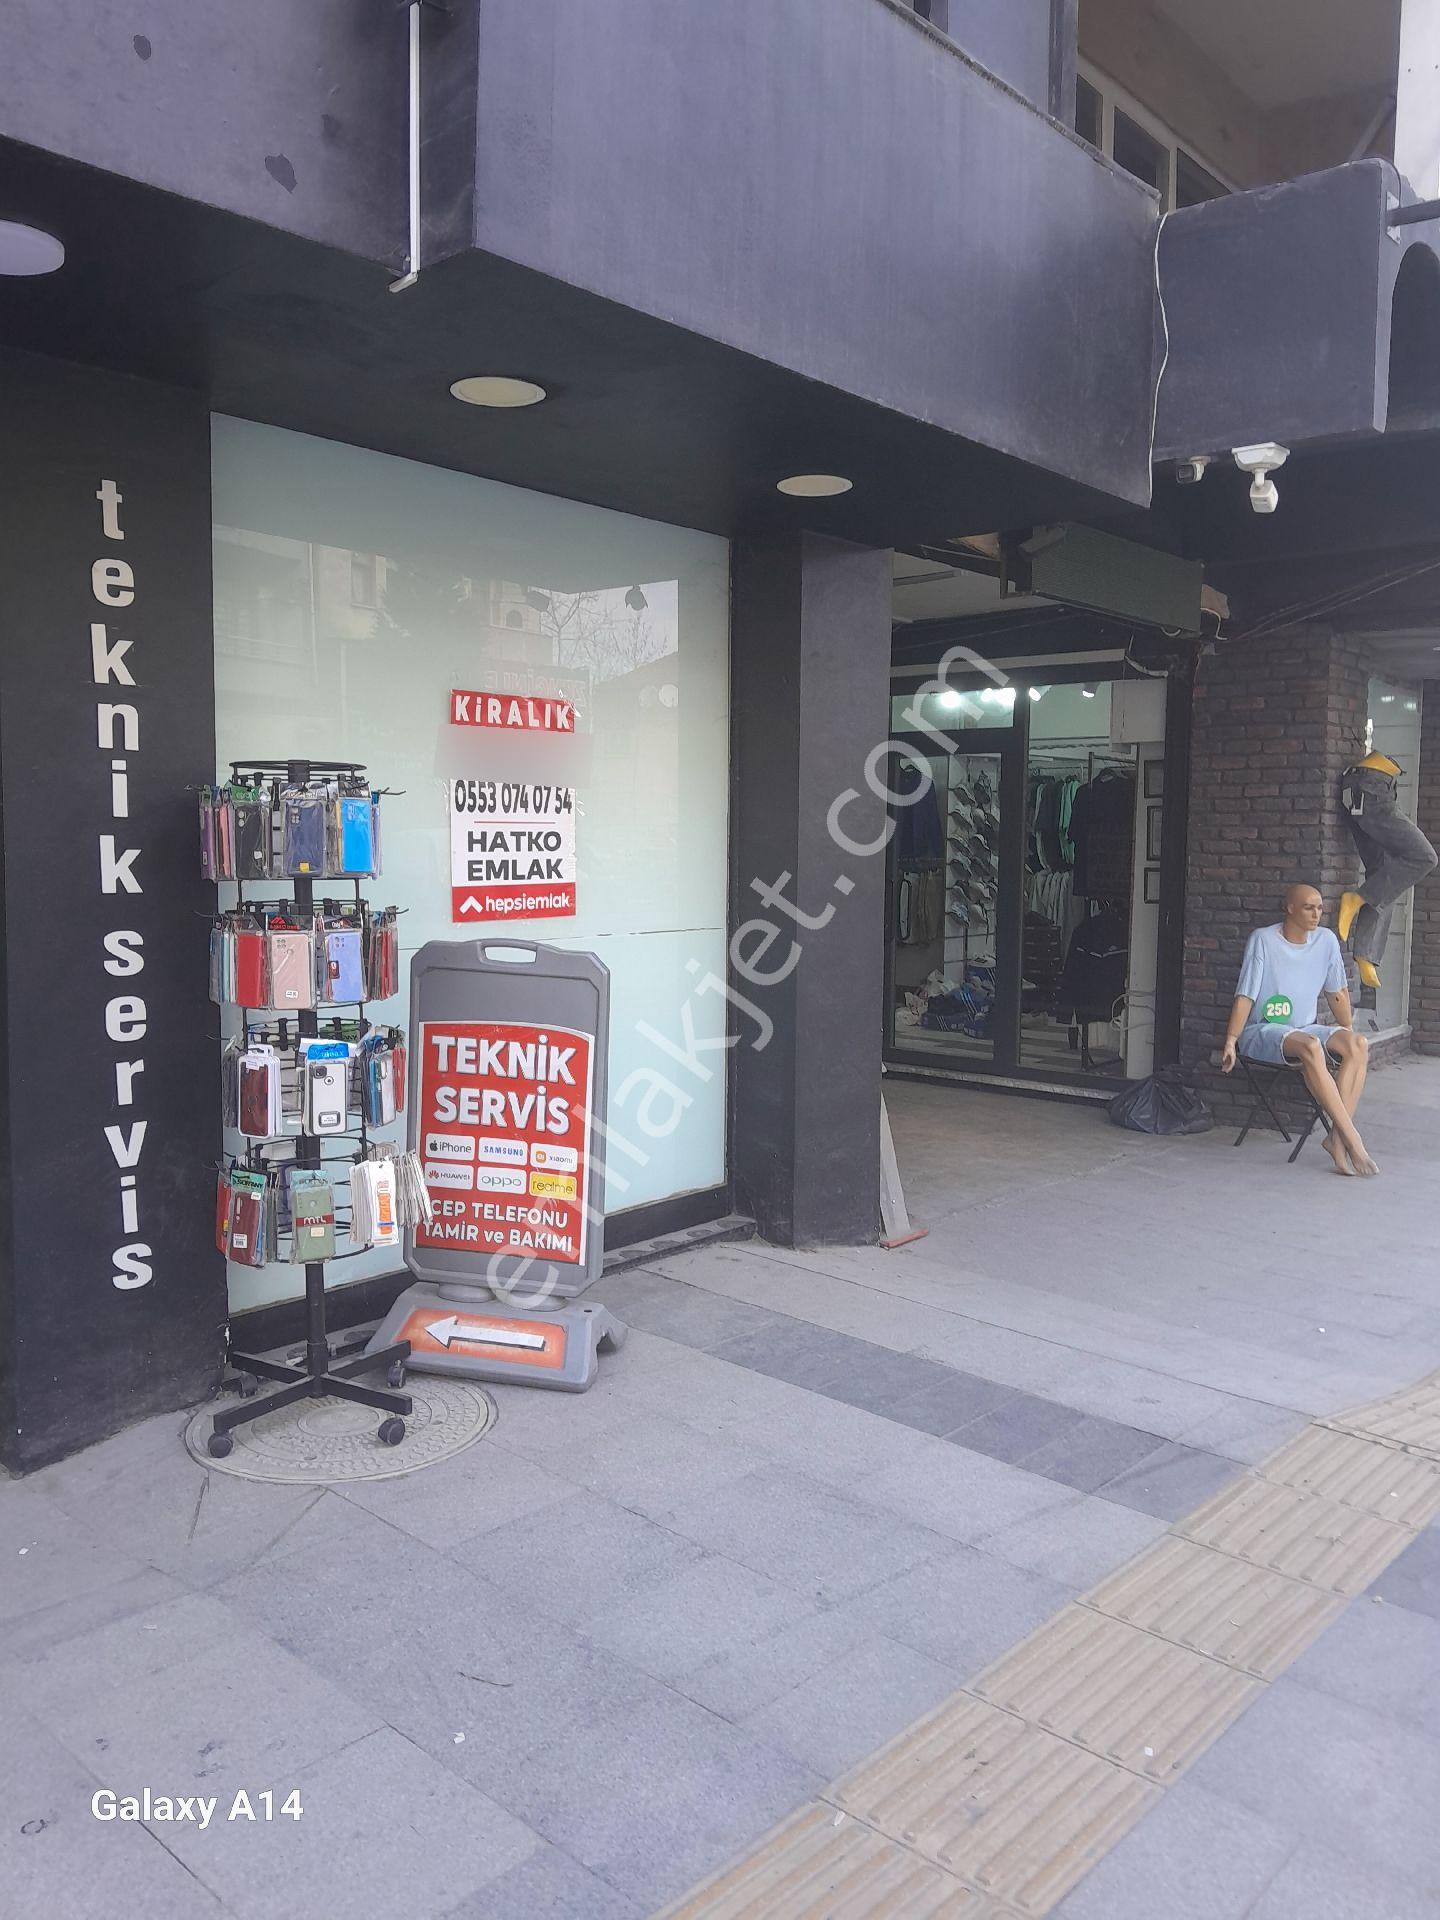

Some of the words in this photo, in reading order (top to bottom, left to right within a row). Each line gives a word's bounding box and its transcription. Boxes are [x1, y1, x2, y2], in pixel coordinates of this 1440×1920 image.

[91, 480, 143, 893] teknik
[455, 780, 497, 813] 0553
[501, 782, 529, 814] 074
[533, 785, 551, 814] 07
[554, 787, 572, 814] 54
[467, 831, 562, 853] HATKO
[467, 858, 563, 881] EMLAK
[486, 892, 571, 914] hepsiemlak
[1266, 1002, 1291, 1017] 250
[431, 1034, 577, 1086] TEKNİK
[103, 930, 153, 1290] servis
[433, 1085, 571, 1136] SERVİS
[439, 1141, 472, 1154] iPhone
[484, 1145, 524, 1157] SAMSUNG
[440, 1172, 471, 1181] HUAWEI
[531, 1179, 574, 1194] realme
[431, 1200, 466, 1218] CEP
[472, 1202, 568, 1229] TELEFONU
[483, 1229, 505, 1244] ve
[509, 1229, 573, 1253] BAKIMI
